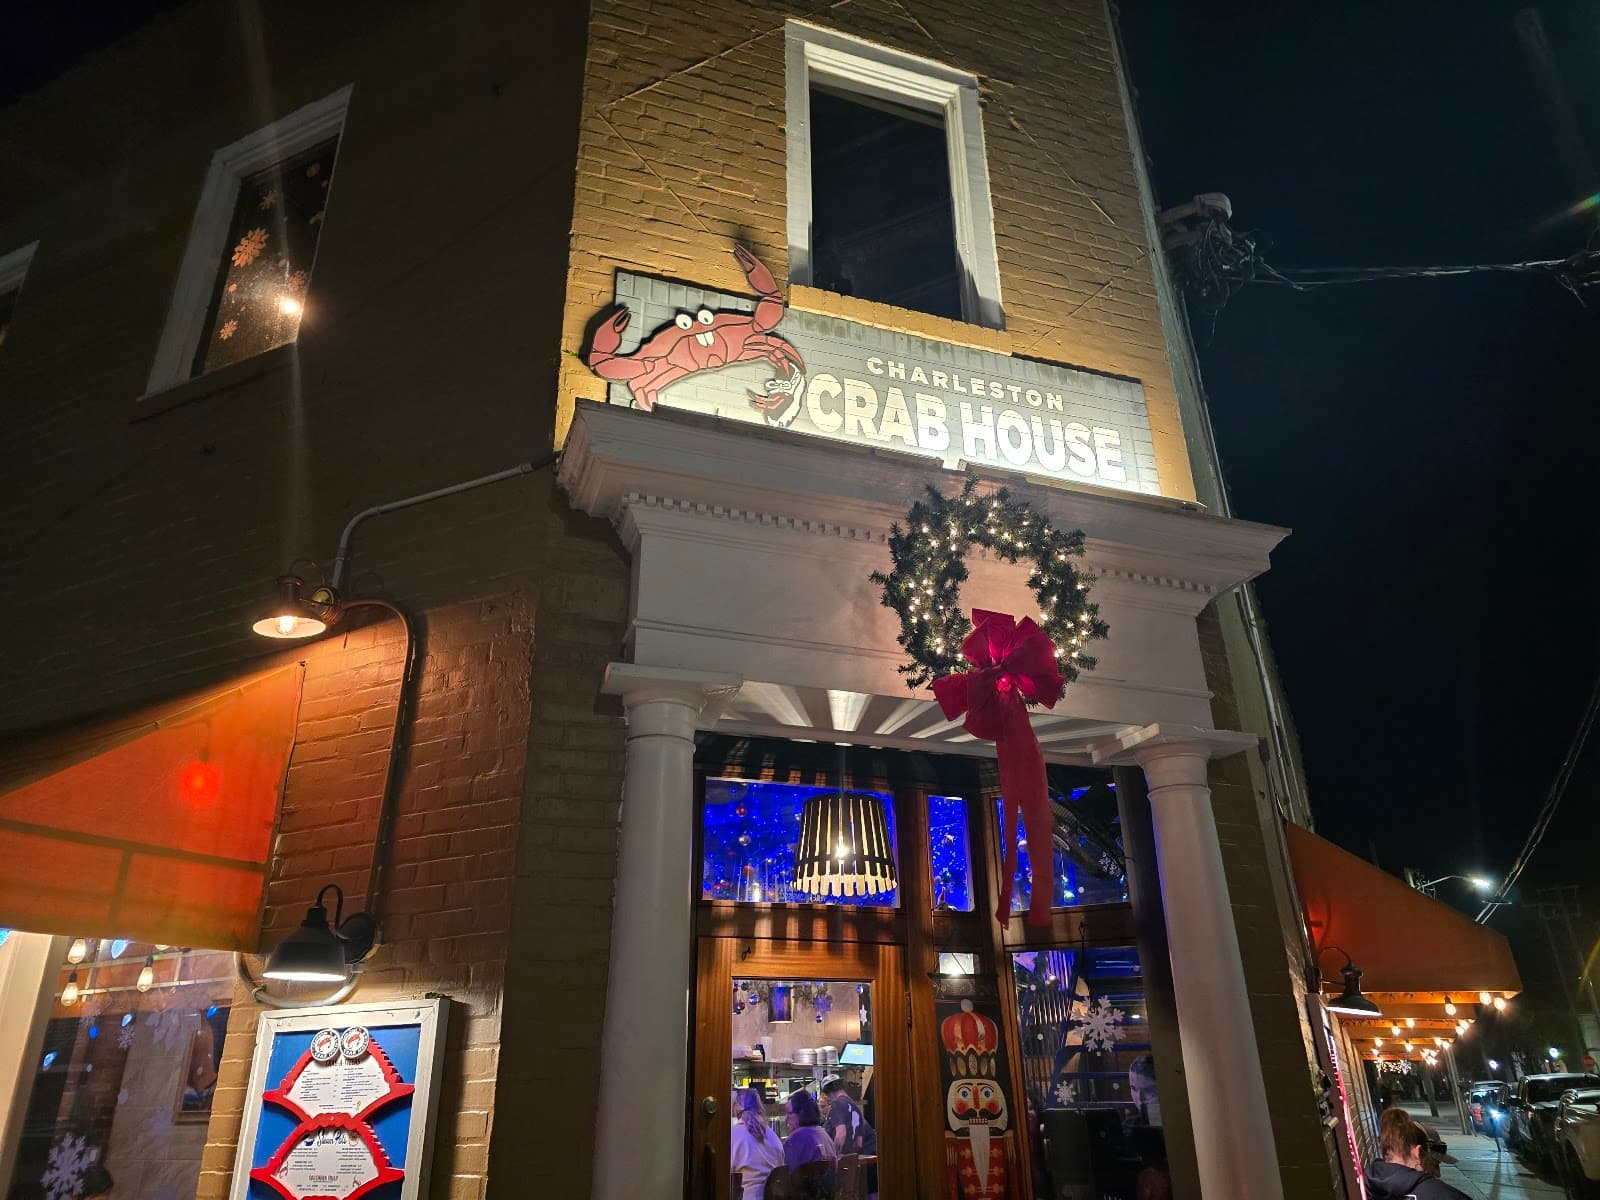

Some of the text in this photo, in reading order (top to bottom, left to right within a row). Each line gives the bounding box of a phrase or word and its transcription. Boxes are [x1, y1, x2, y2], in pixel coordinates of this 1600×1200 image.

[866, 356, 1065, 412] CHARLESTON
[806, 373, 1127, 483] CRAB HOUSE
